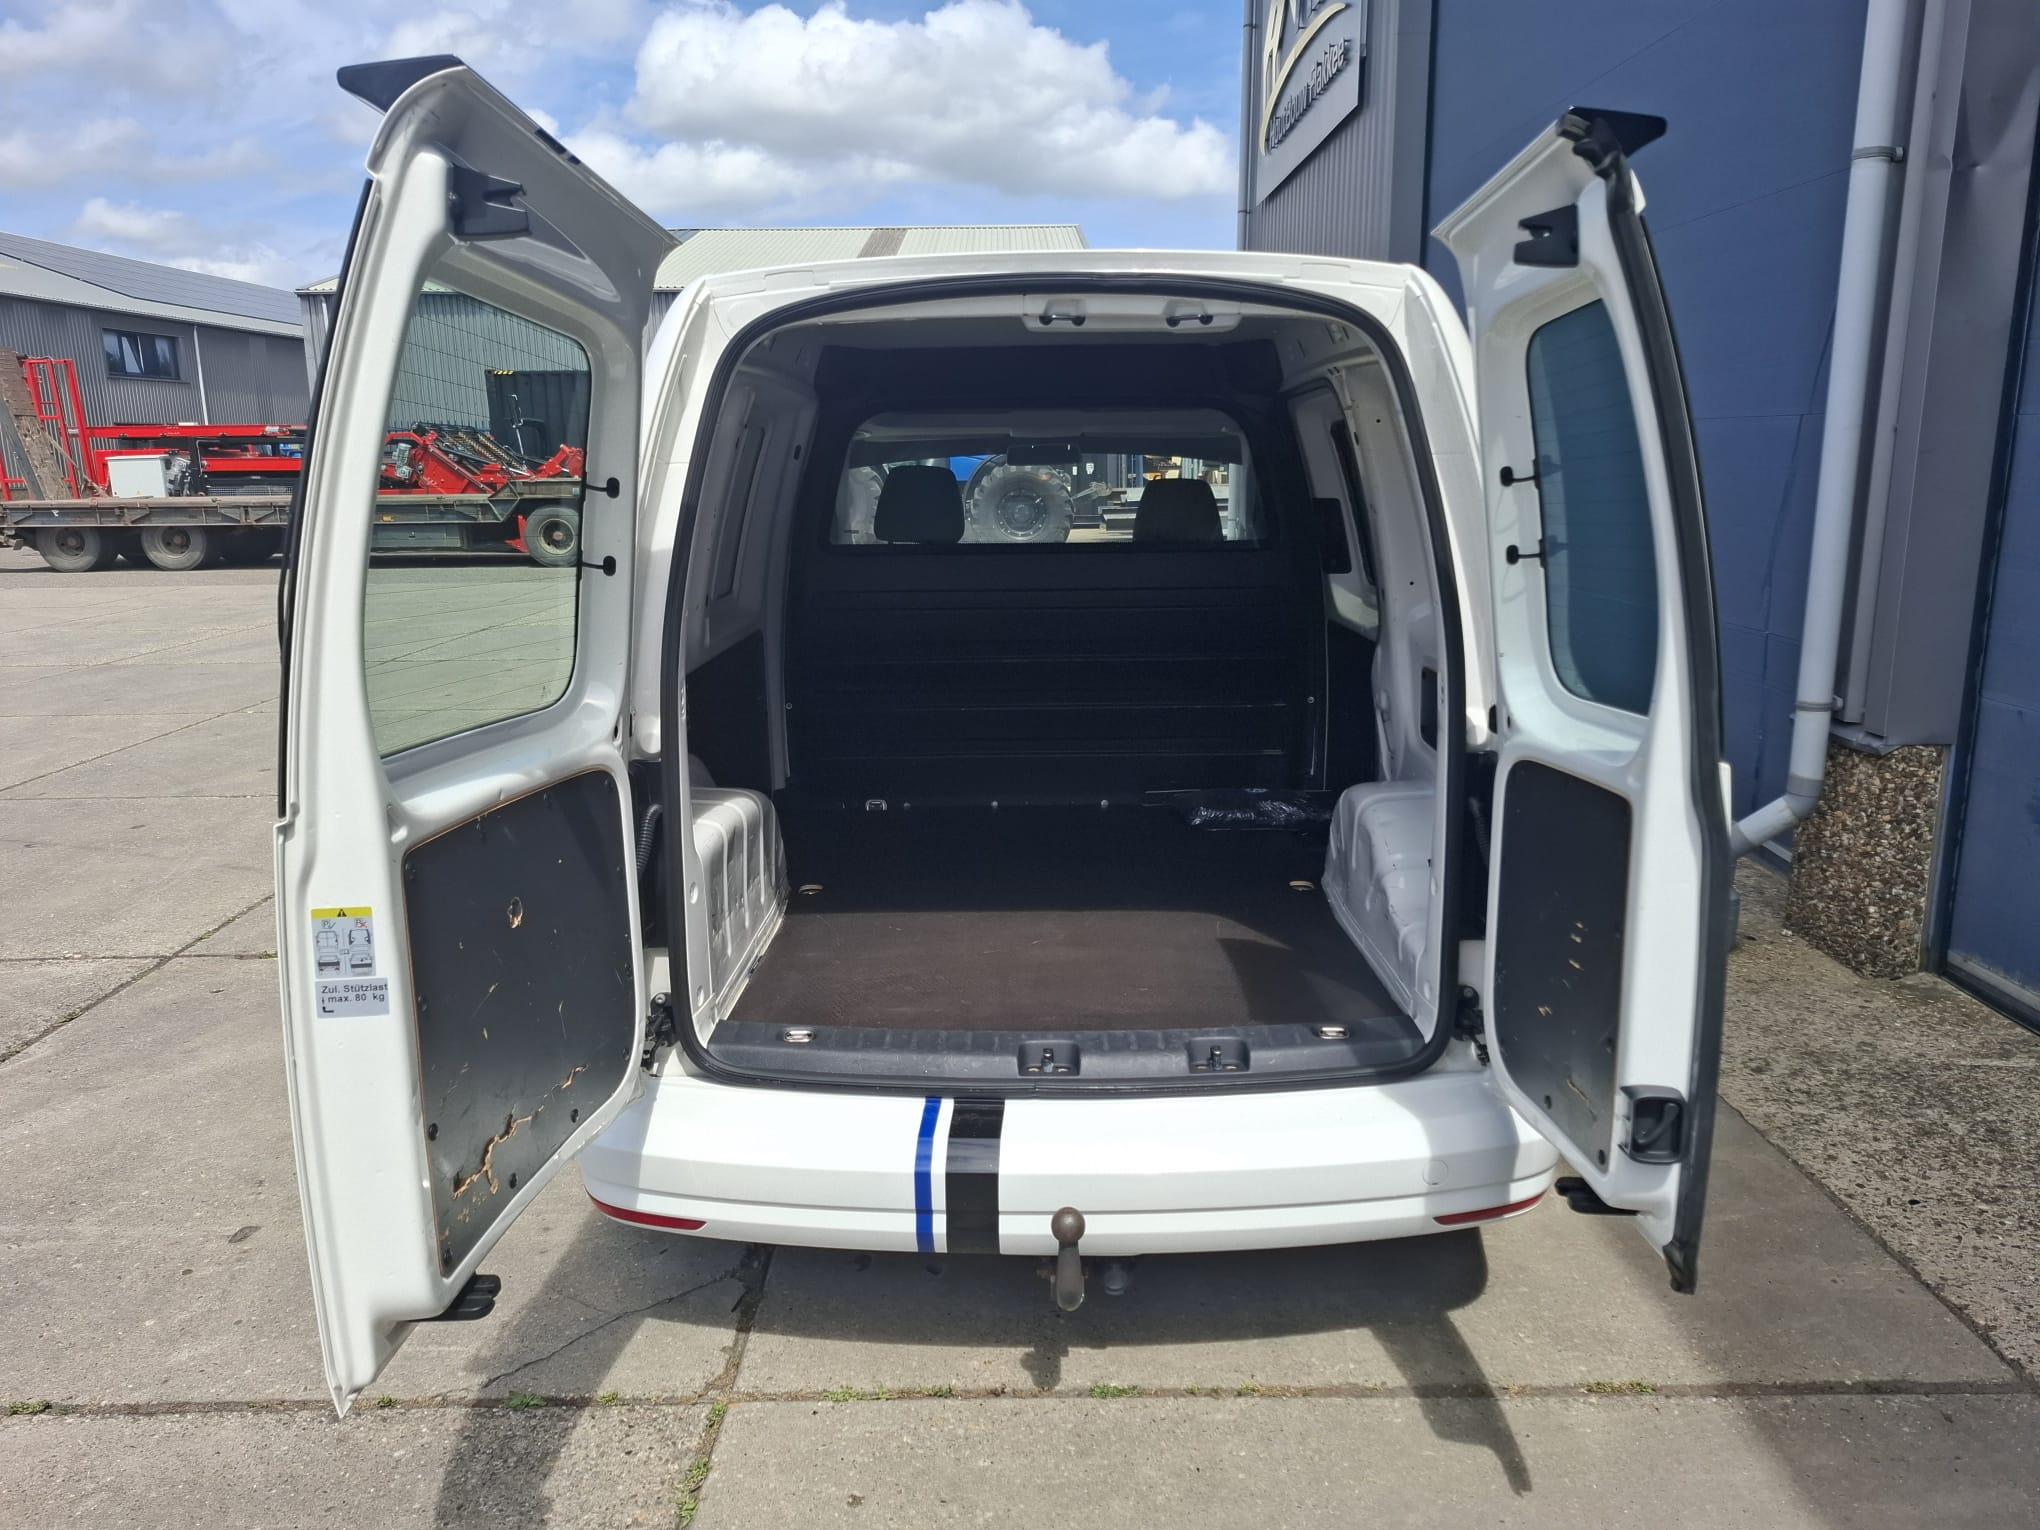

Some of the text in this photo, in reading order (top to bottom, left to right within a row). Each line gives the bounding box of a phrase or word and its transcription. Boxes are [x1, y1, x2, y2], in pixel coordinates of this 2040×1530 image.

[321, 984, 388, 994] Zul. Stützlast
[355, 993, 367, 1001] 80
[373, 993, 385, 1001] kg
